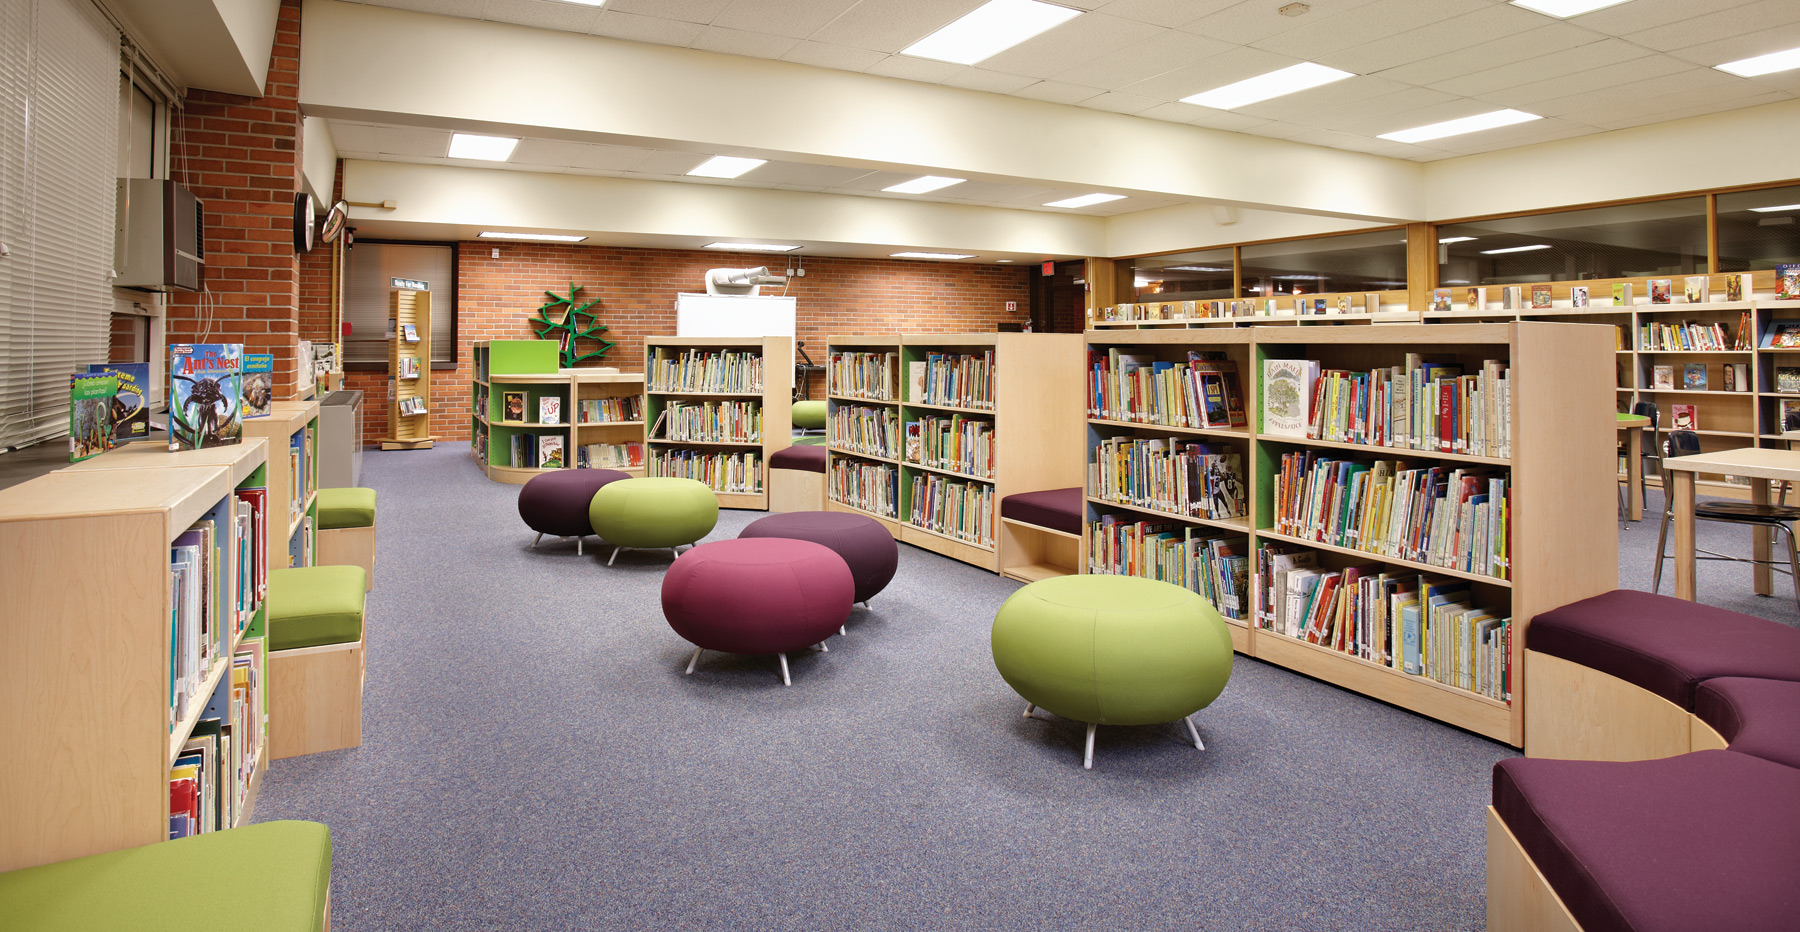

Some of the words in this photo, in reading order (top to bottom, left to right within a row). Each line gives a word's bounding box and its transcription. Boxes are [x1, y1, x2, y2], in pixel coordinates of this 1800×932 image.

[183, 357, 214, 374] Ant's
[216, 357, 239, 369] Nest
[1267, 363, 1281, 378] RAIN
[104, 368, 135, 382] Ereme
[1210, 385, 1220, 394] SPY
[1268, 418, 1302, 429] APPLESAUCE
[1145, 525, 1153, 534] WE
